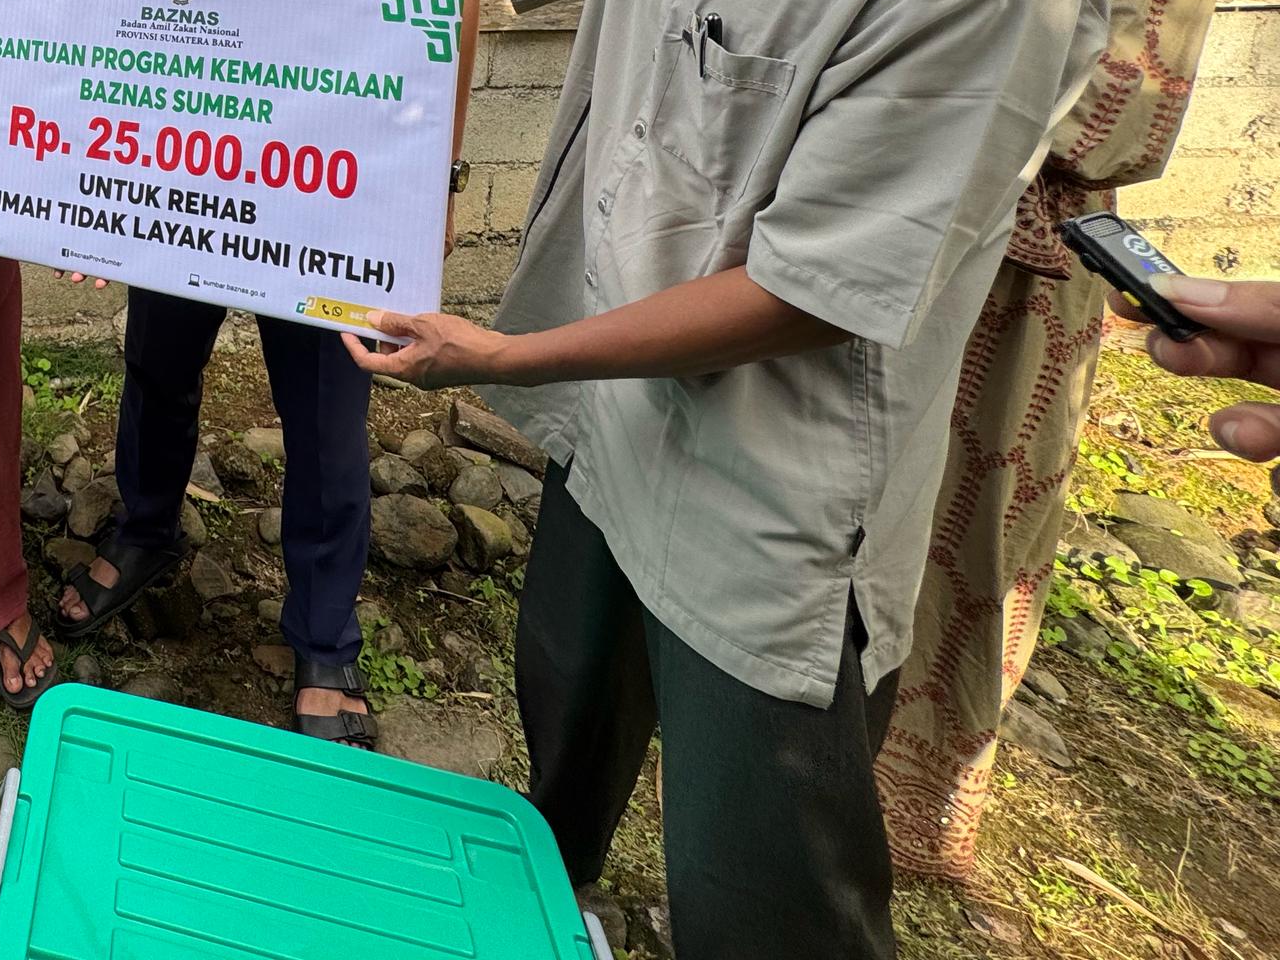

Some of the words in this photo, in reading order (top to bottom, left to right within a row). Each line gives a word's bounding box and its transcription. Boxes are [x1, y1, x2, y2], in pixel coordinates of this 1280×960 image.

[116, 30, 158, 41] PROVINSI
[160, 33, 209, 46] SUMATERA
[212, 39, 243, 48] BARAT
[120, 19, 147, 29] Badan
[149, 21, 170, 31] Amil
[173, 23, 197, 33] Zakat
[200, 25, 240, 37] Nasional
[141, 6, 219, 26] BAZNAS
[91, 46, 205, 80] PROGRAM
[210, 57, 403, 101] KEMANUSIAAN
[80, 78, 167, 110] BAZNAS
[172, 88, 273, 124] SUMBAR
[8, 105, 71, 162] Rp.
[85, 116, 359, 199] 25.000.000
[79, 173, 162, 209] UNTUK
[167, 188, 257, 225] REHAB
[58, 201, 127, 236] TIDAK
[133, 216, 216, 254] LAYAK
[221, 232, 291, 268] HUNI
[298, 245, 395, 294] (RTLH)
